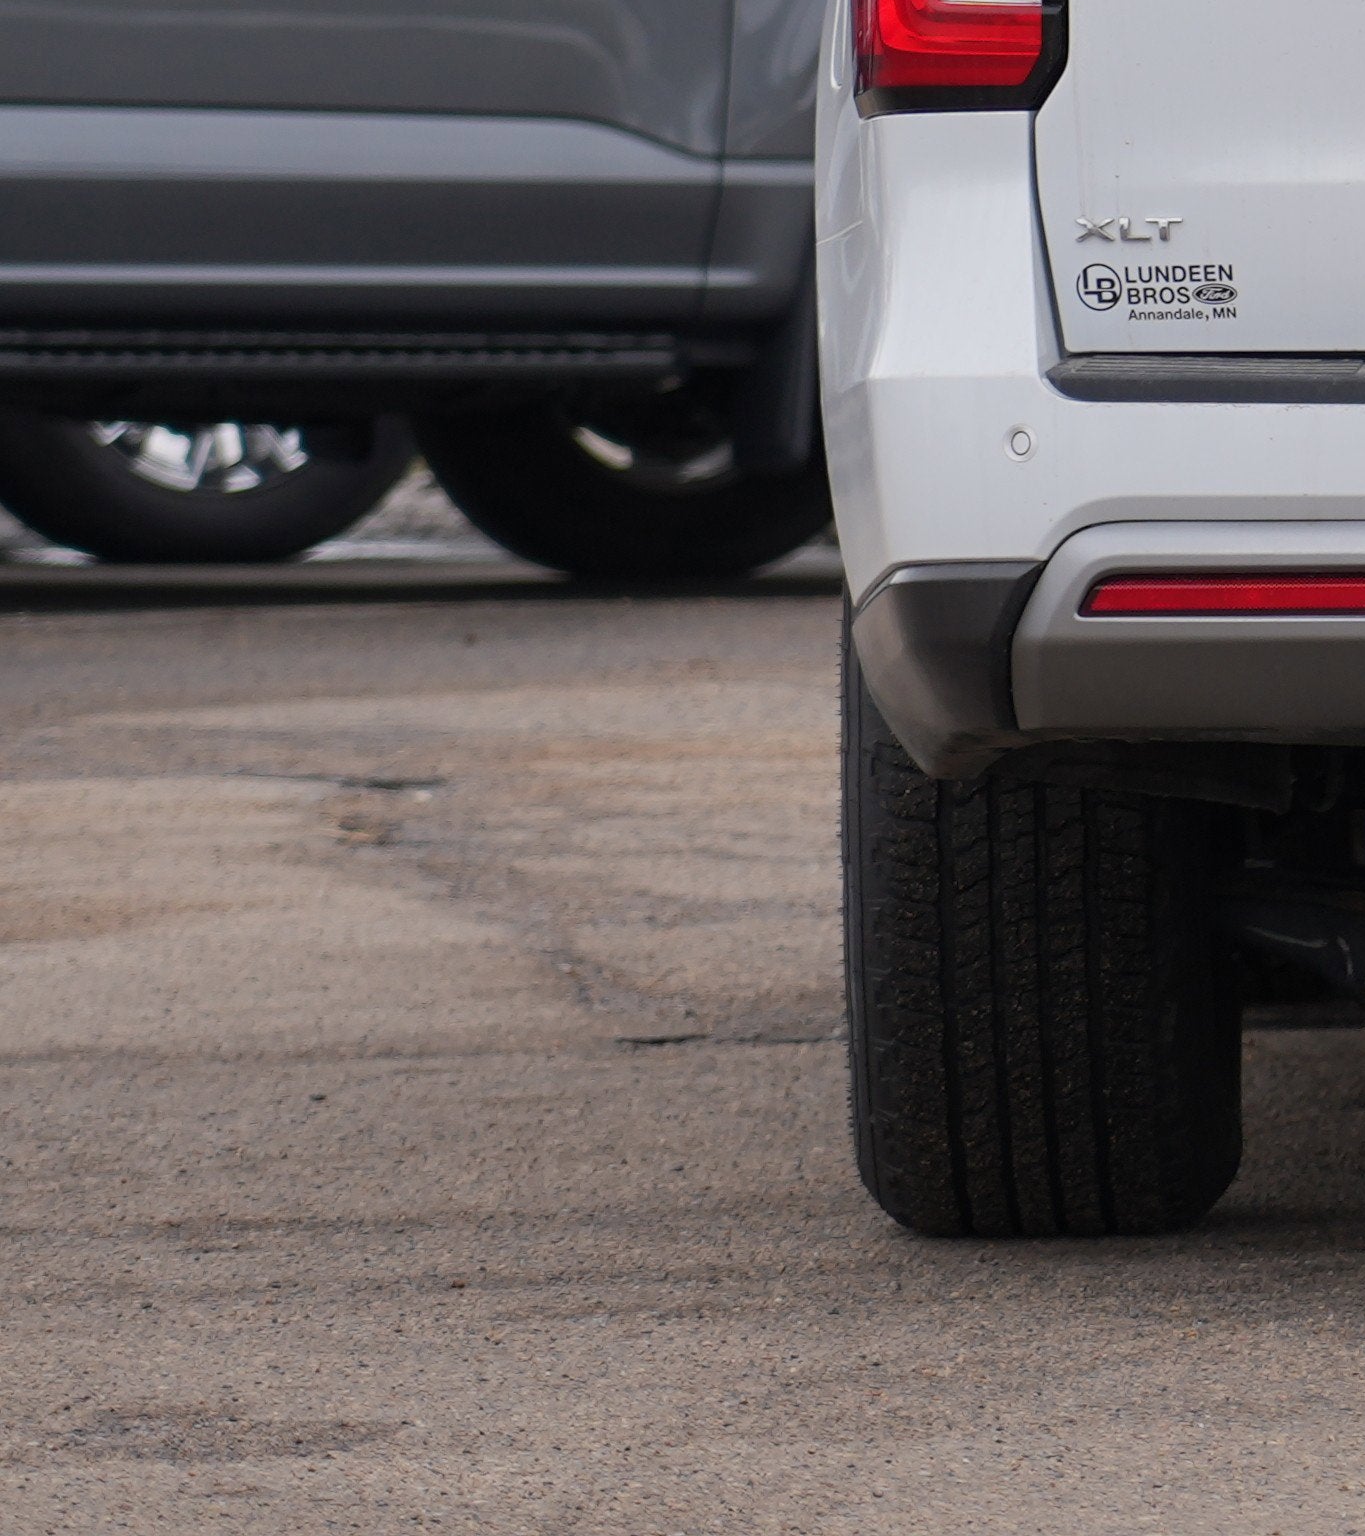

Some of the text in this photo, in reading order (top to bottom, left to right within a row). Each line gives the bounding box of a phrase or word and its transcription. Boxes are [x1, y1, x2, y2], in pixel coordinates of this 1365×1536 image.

[1075, 216, 1184, 243] XLT
[1124, 264, 1233, 284] LUNDEEN
[1127, 286, 1191, 305] BROS
[1128, 306, 1237, 322] Annandale, MN
